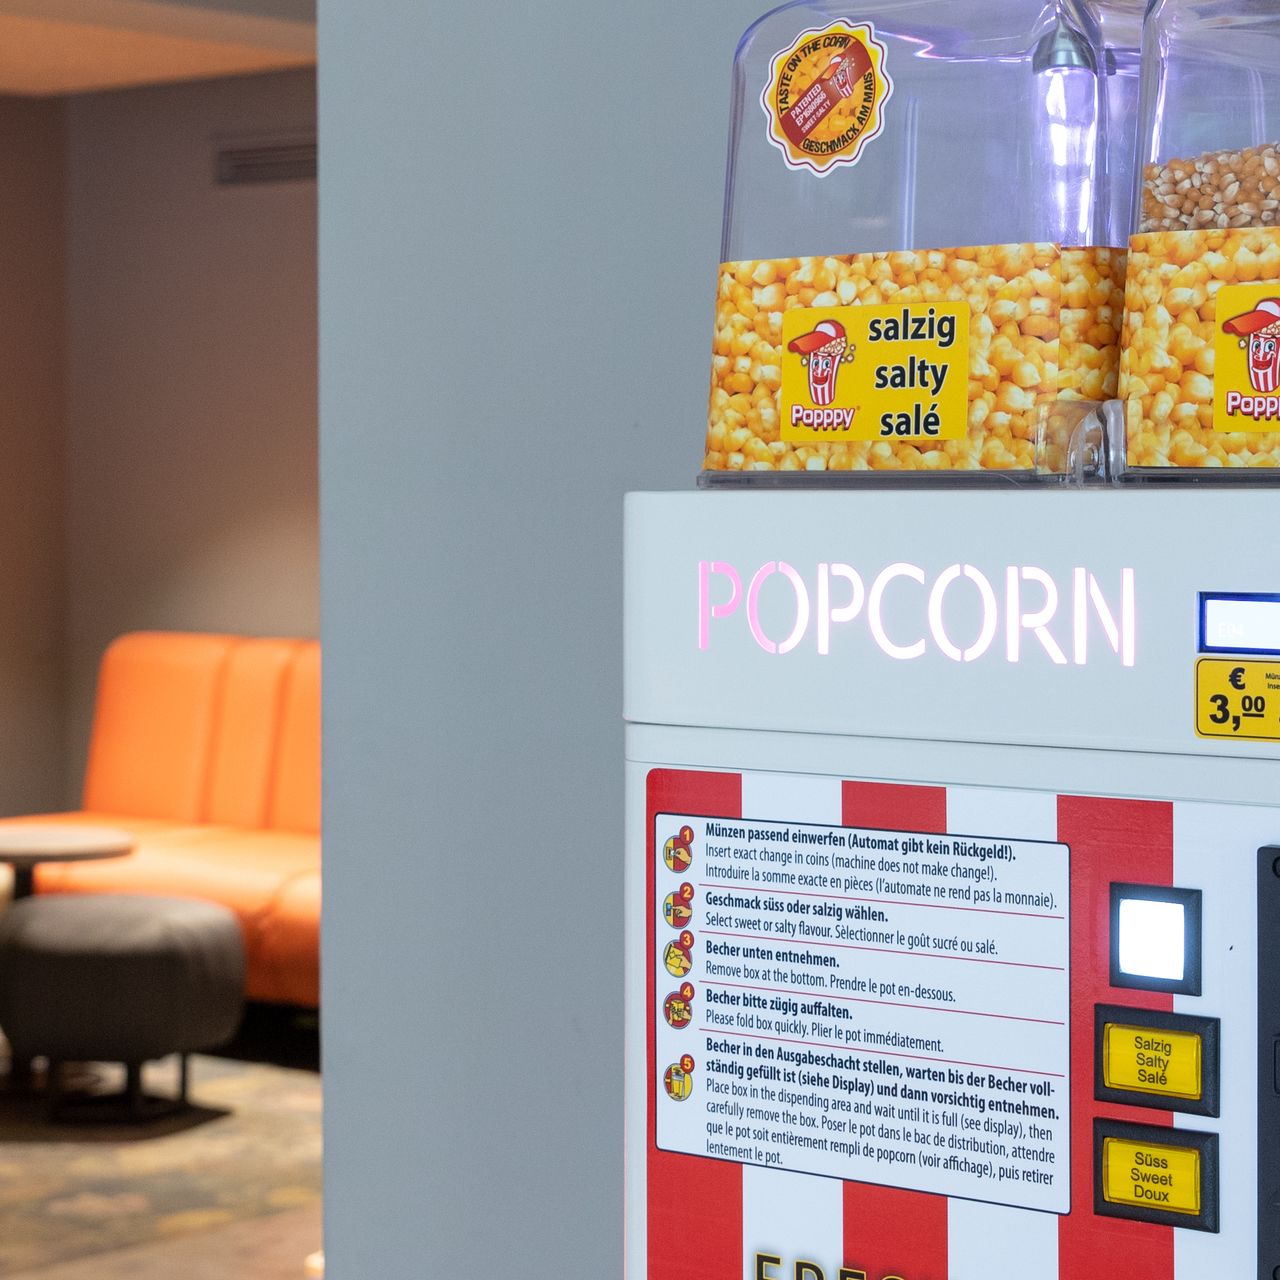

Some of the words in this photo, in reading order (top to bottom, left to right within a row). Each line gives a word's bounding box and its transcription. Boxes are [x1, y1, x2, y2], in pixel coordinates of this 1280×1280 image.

[779, 73, 792, 114] TASTE
[787, 55, 802, 72] ON
[800, 39, 821, 58] THE
[823, 36, 851, 50] CORN
[863, 72, 873, 102] MAIS
[790, 84, 822, 119] PATENTED
[857, 105, 870, 126] AM
[802, 124, 860, 153] GESCHMACK
[868, 308, 956, 347] salzig
[874, 355, 948, 396] salty
[791, 404, 856, 431] Popppy
[880, 403, 941, 436] salé
[698, 560, 1135, 667] POPCORN
[1229, 667, 1246, 690] €
[684, 829, 690, 841] 1
[705, 822, 745, 839] Münzen
[748, 828, 789, 843] passend
[791, 829, 846, 847] einwerfen
[848, 832, 899, 852] (Automat
[901, 837, 924, 856] gibt
[926, 838, 950, 856] kein
[953, 841, 1016, 863] Rückgeld!).
[706, 843, 731, 859] Insert
[733, 848, 757, 861] exact
[759, 847, 792, 867] change
[794, 850, 803, 865] in
[805, 851, 829, 867] coins
[831, 852, 876, 871] (machine
[878, 856, 901, 873] does
[903, 861, 919, 875] not
[921, 861, 949, 877] make
[950, 862, 997, 884] change!).
[683, 886, 691, 899] 2
[706, 863, 750, 881] Introduire
[752, 867, 760, 882] la
[762, 871, 796, 885] somme
[798, 874, 828, 888] exacte
[830, 877, 842, 889] en
[844, 875, 873, 893] pièces
[934, 886, 946, 898] ne
[948, 885, 971, 901] rend
[973, 889, 991, 905] pas
[993, 887, 1002, 904] la
[1005, 892, 1057, 910] monnaie).
[705, 891, 761, 910] Geschmack
[763, 897, 785, 912] süss
[786, 899, 811, 915] oder
[812, 902, 843, 922] salzig
[844, 905, 888, 923] wählen.
[683, 934, 691, 946] 3
[705, 911, 733, 928] Select
[734, 917, 761, 931] sweet
[763, 920, 773, 932] or
[774, 918, 797, 938] salty
[798, 920, 833, 938] flavour.
[896, 930, 905, 946] le
[907, 932, 930, 950] goût
[932, 936, 958, 951] sucré
[960, 940, 973, 953] ou
[975, 939, 998, 955] salé.
[706, 939, 741, 957] Becher
[742, 946, 773, 961] unten
[775, 950, 840, 969] entnehmen.
[683, 986, 691, 998] 4
[706, 960, 742, 978] Remove
[743, 964, 760, 980] box
[761, 968, 771, 981] at
[773, 968, 788, 983] the
[790, 969, 828, 988] bottom.
[830, 973, 867, 992] Prendre
[868, 978, 878, 994] le
[879, 982, 896, 998] pot
[898, 983, 956, 1003] en-dessous.
[706, 988, 741, 1007] Becher
[742, 992, 768, 1010] bitte
[769, 996, 798, 1017] zügig
[800, 1001, 853, 1020] auffalten.
[706, 1008, 734, 1026] Please
[736, 1012, 754, 1029] fold
[756, 1014, 773, 1031] box
[774, 1019, 809, 1039] quickly.
[811, 1021, 833, 1038] Plier
[834, 1024, 843, 1040] le
[845, 1029, 861, 1045] pot
[863, 1028, 944, 1053] immédiatement.
[1134, 1036, 1172, 1057] Salzig
[684, 1058, 691, 1069] 5
[706, 1037, 741, 1056] Becher
[743, 1041, 753, 1057] in
[755, 1043, 774, 1060] den
[776, 1046, 861, 1072] Ausgabeschacht
[862, 1059, 903, 1079] stellen,
[905, 1066, 945, 1083] warten
[948, 1068, 964, 1085] bis
[966, 1071, 986, 1088] der
[988, 1073, 1028, 1094] Becher
[1029, 1081, 1055, 1097] voll-
[1136, 1052, 1169, 1072] Salty
[1137, 1069, 1168, 1085] Salé
[706, 1058, 744, 1080] ständig
[746, 1064, 781, 1082] gefüllt
[783, 1067, 796, 1084] ist
[798, 1070, 830, 1089] (siehe
[832, 1074, 875, 1097] Display)
[877, 1082, 898, 1098] und
[900, 1084, 928, 1102] dann
[930, 1091, 985, 1114] vorsichtig
[988, 1099, 1059, 1120] entnehmen.
[706, 1138, 753, 1160] lentement
[755, 1146, 763, 1162] le
[765, 1151, 783, 1165] pot.
[1134, 1151, 1168, 1169] Süss
[1130, 1167, 1173, 1187] Sweet
[1134, 1184, 1170, 1203] Doux
